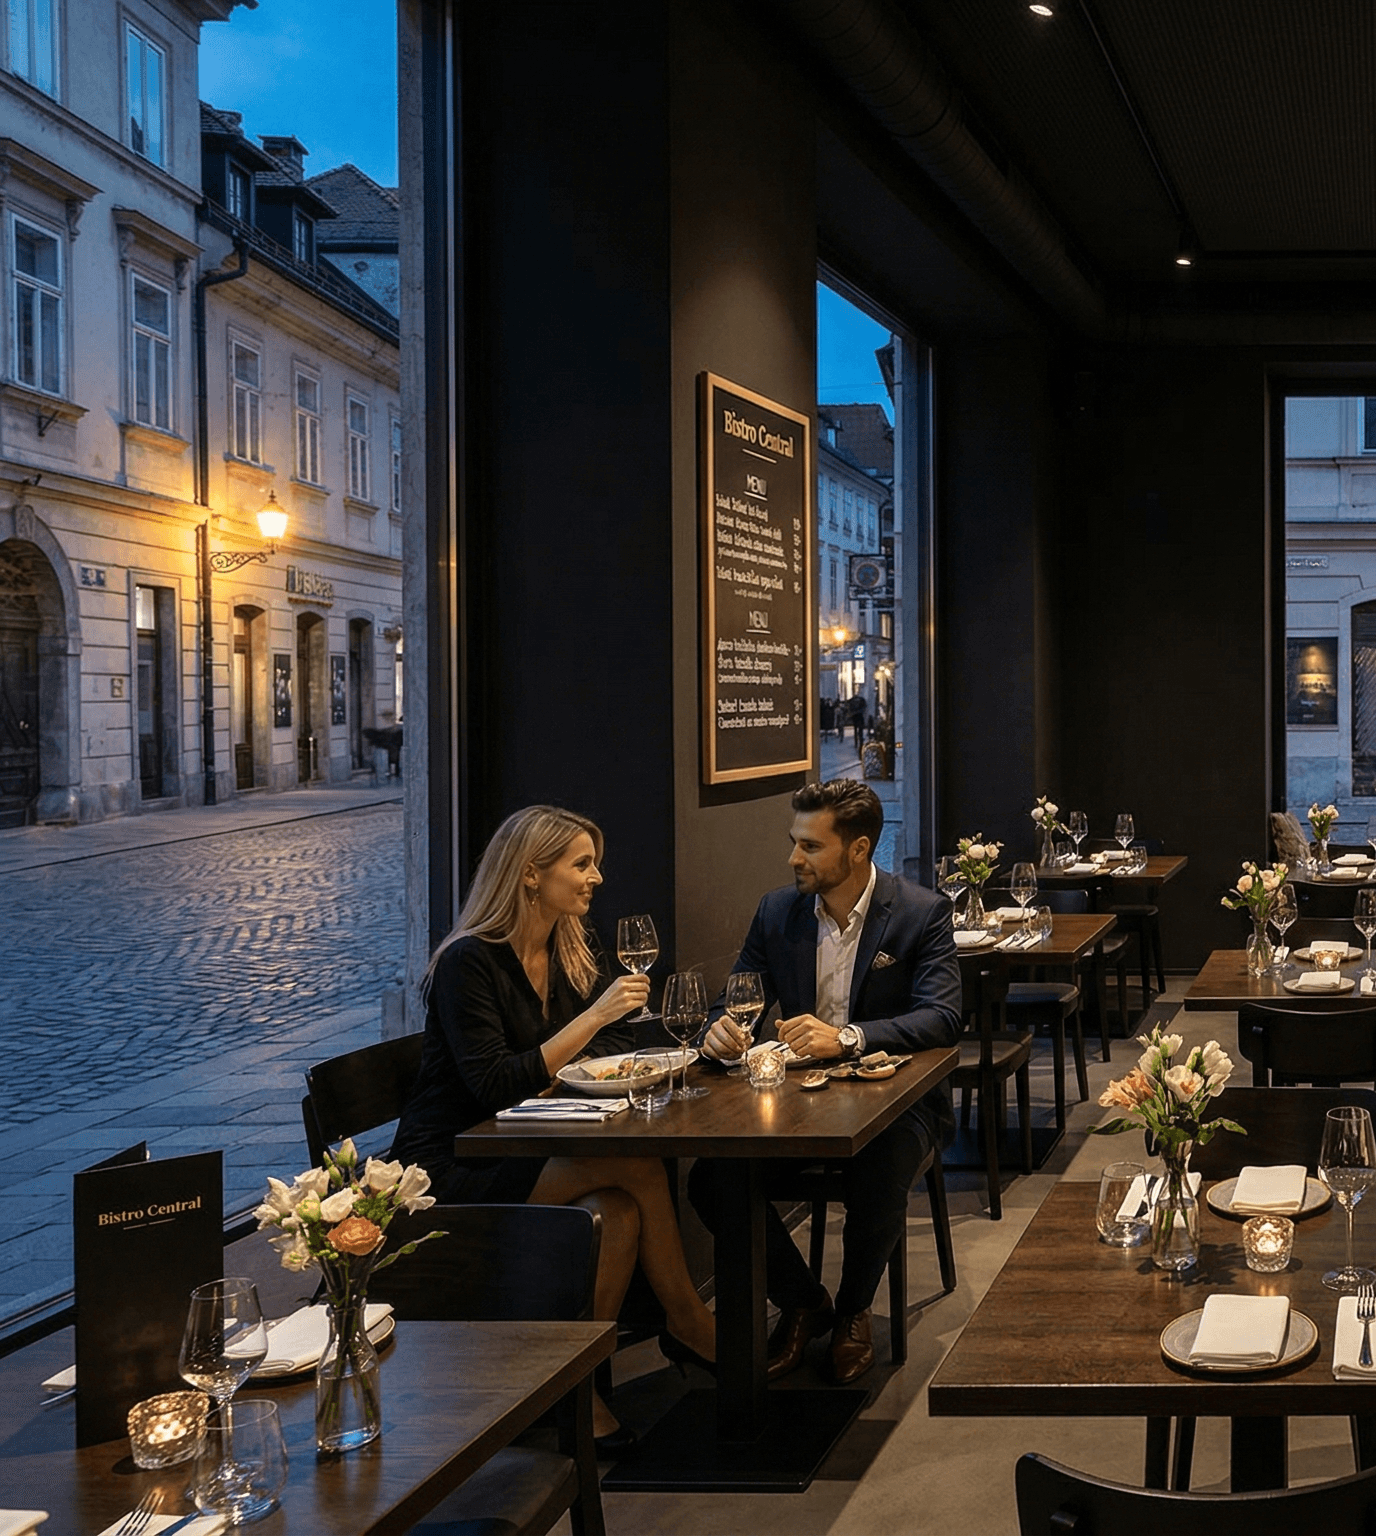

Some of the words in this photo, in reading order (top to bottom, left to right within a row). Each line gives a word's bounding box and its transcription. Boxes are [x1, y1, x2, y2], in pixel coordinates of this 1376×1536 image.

[723, 409, 757, 444] Bistro
[758, 425, 794, 458] Central
[98, 1210, 144, 1226] Bistro
[147, 1196, 202, 1217] Central
